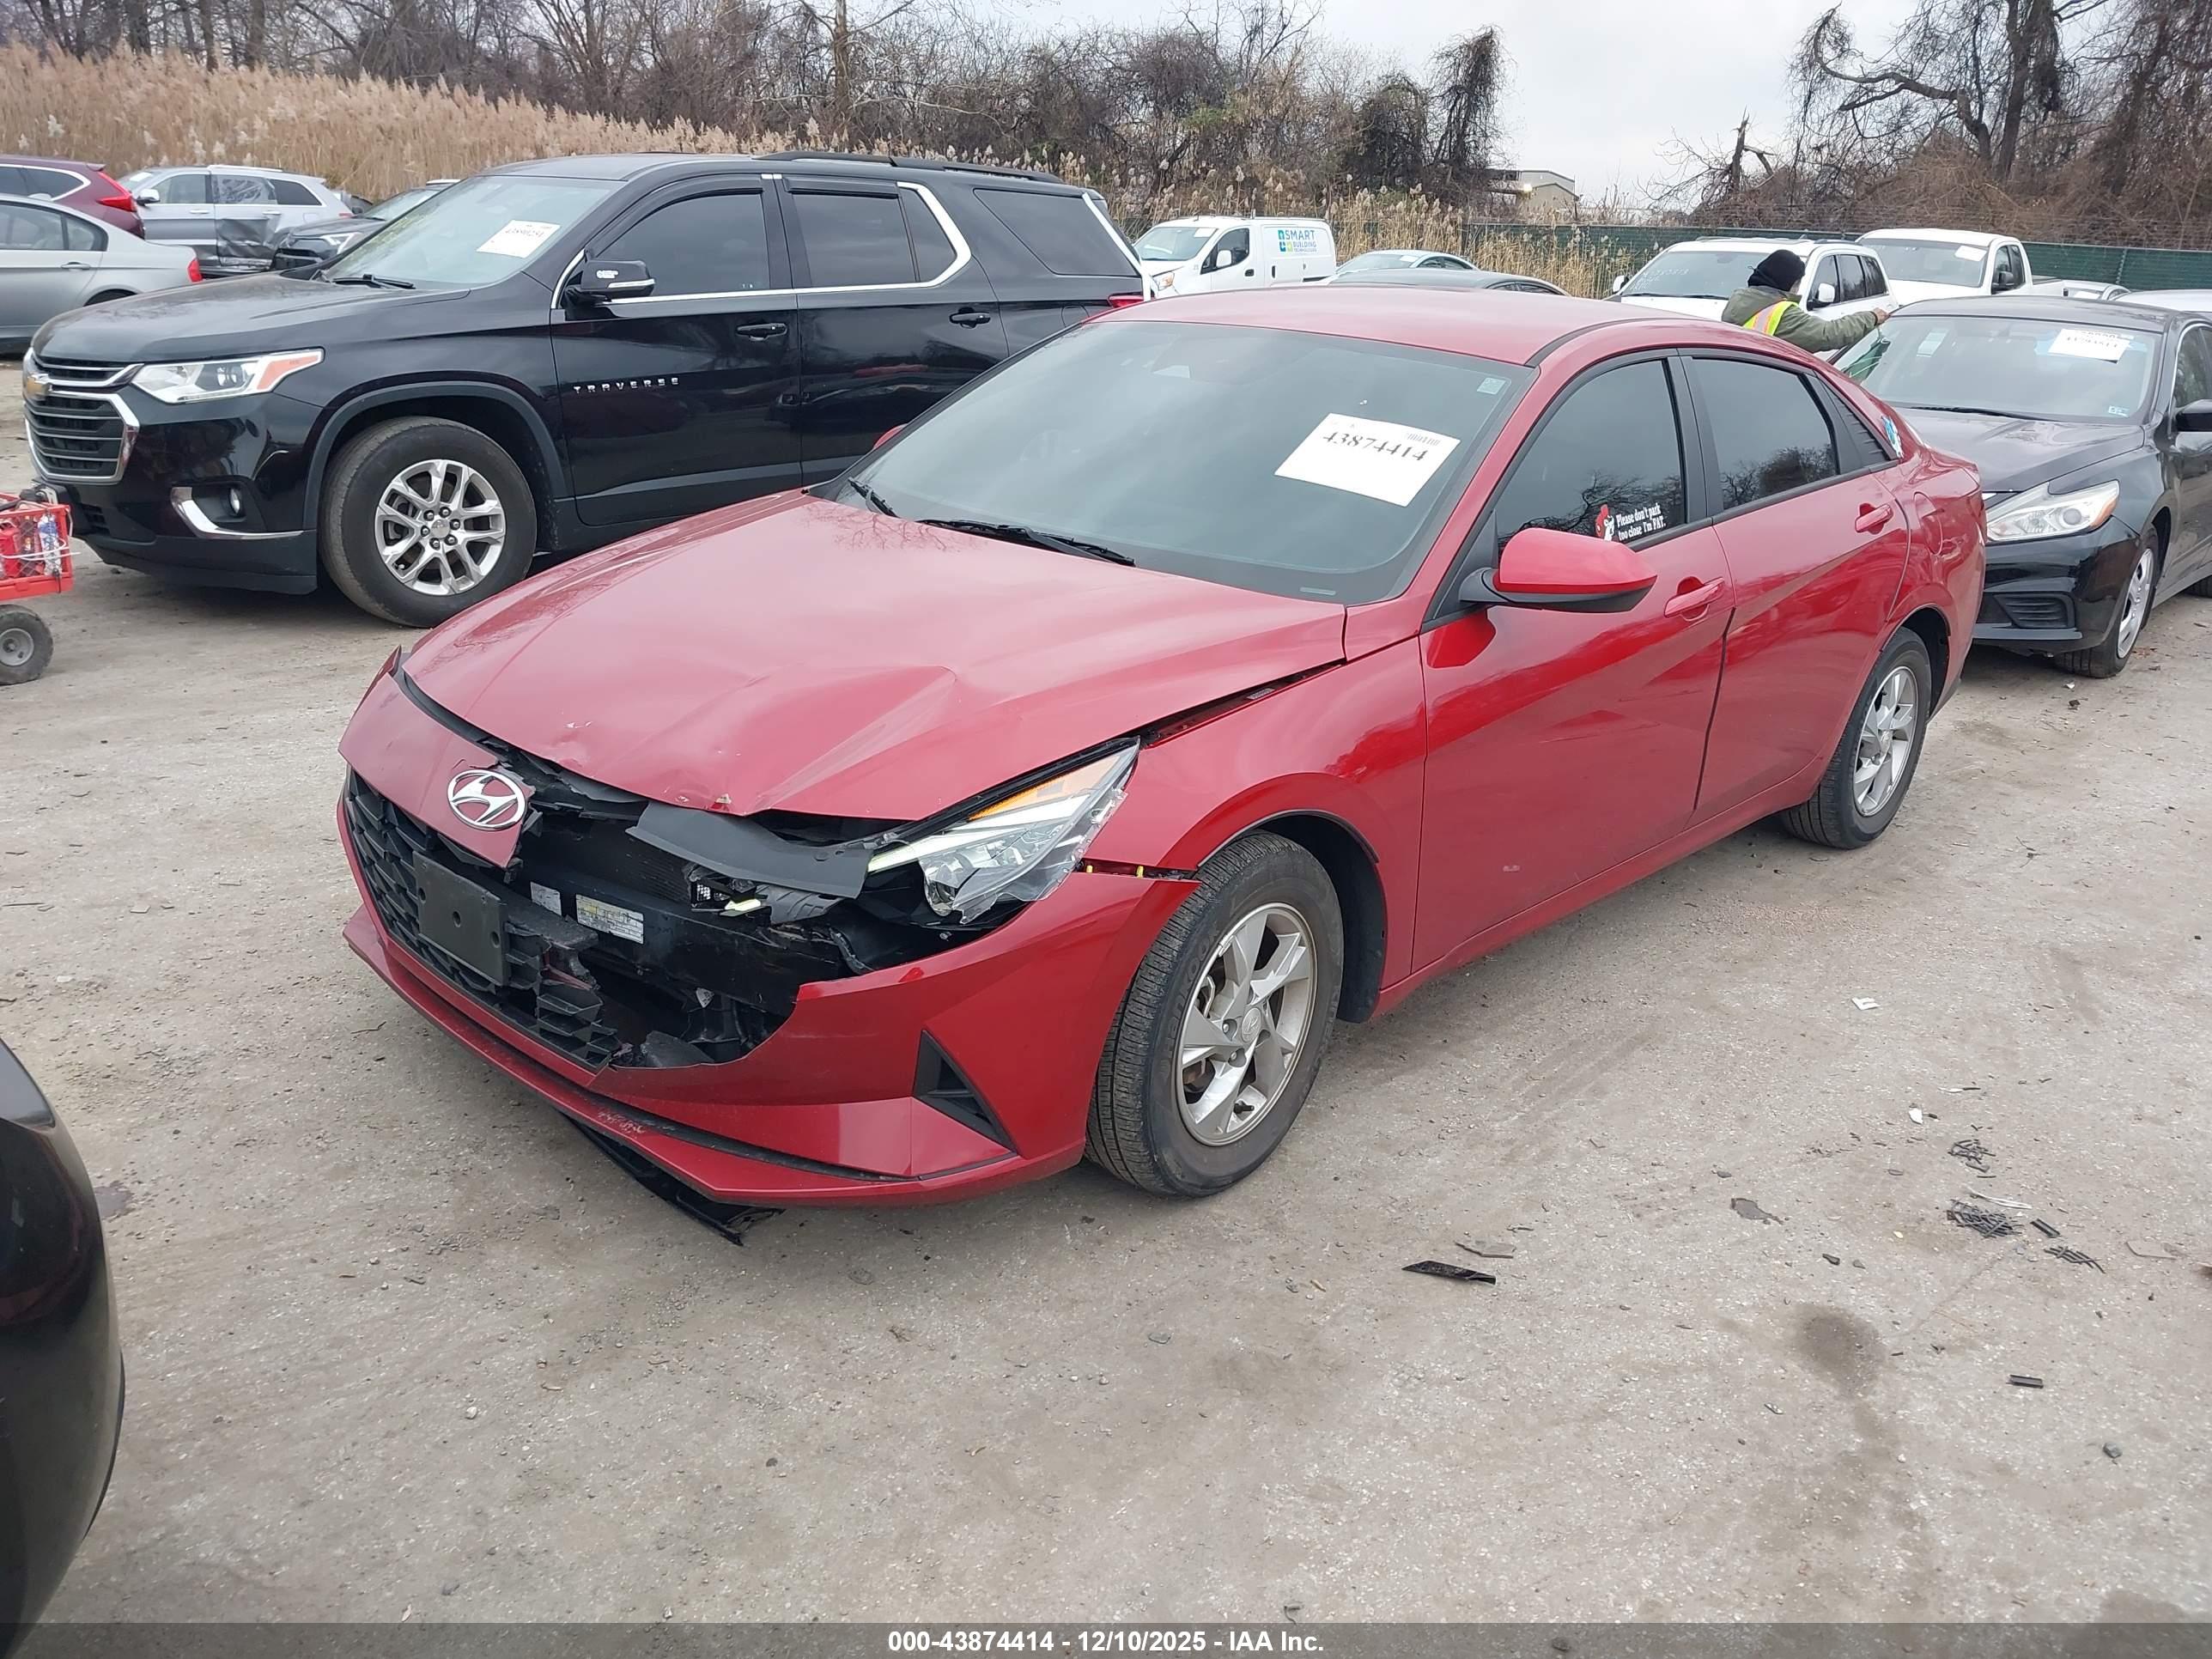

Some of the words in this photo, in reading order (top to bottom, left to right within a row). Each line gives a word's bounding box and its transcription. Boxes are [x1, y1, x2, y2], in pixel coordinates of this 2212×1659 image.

[1285, 229, 1316, 240] SMART
[573, 377, 678, 394] TRAVERSE
[1322, 431, 1429, 461] 43874414
[1615, 513, 1635, 528] Please
[1634, 506, 1649, 521] don't
[1648, 501, 1662, 520] park
[1618, 530, 1629, 541] too
[1628, 525, 1643, 538] close
[1642, 520, 1653, 533] I'm
[1652, 514, 1667, 531] FAT.
